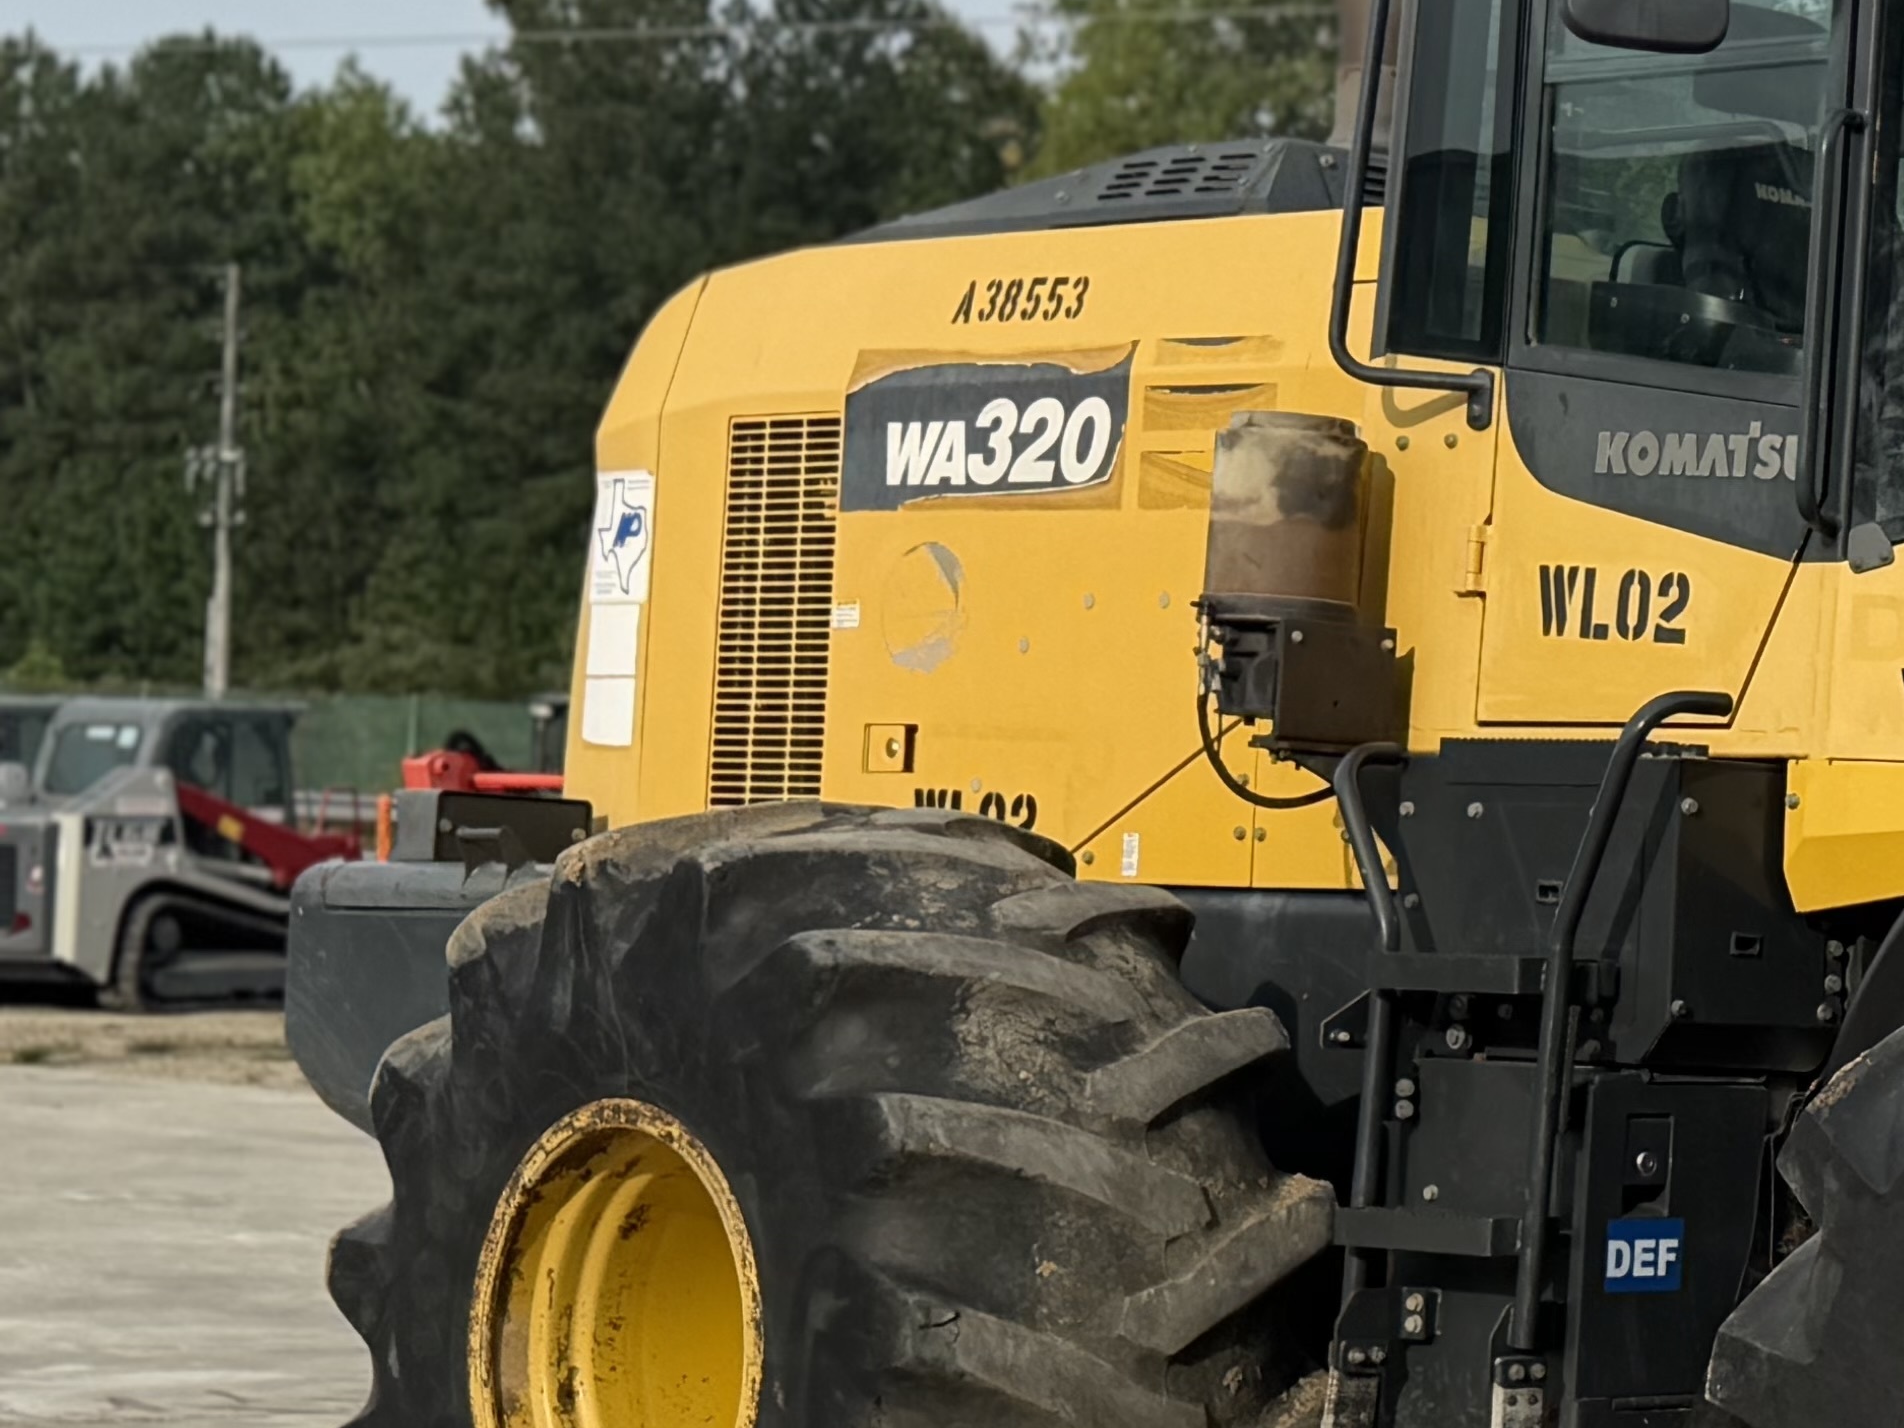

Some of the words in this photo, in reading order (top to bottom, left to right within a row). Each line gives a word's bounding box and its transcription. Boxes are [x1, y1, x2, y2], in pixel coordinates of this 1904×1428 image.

[951, 276, 1090, 324] A38553
[886, 396, 1112, 486] WA320
[1539, 564, 1690, 645] WL02
[1606, 1239, 1679, 1277] DEF
